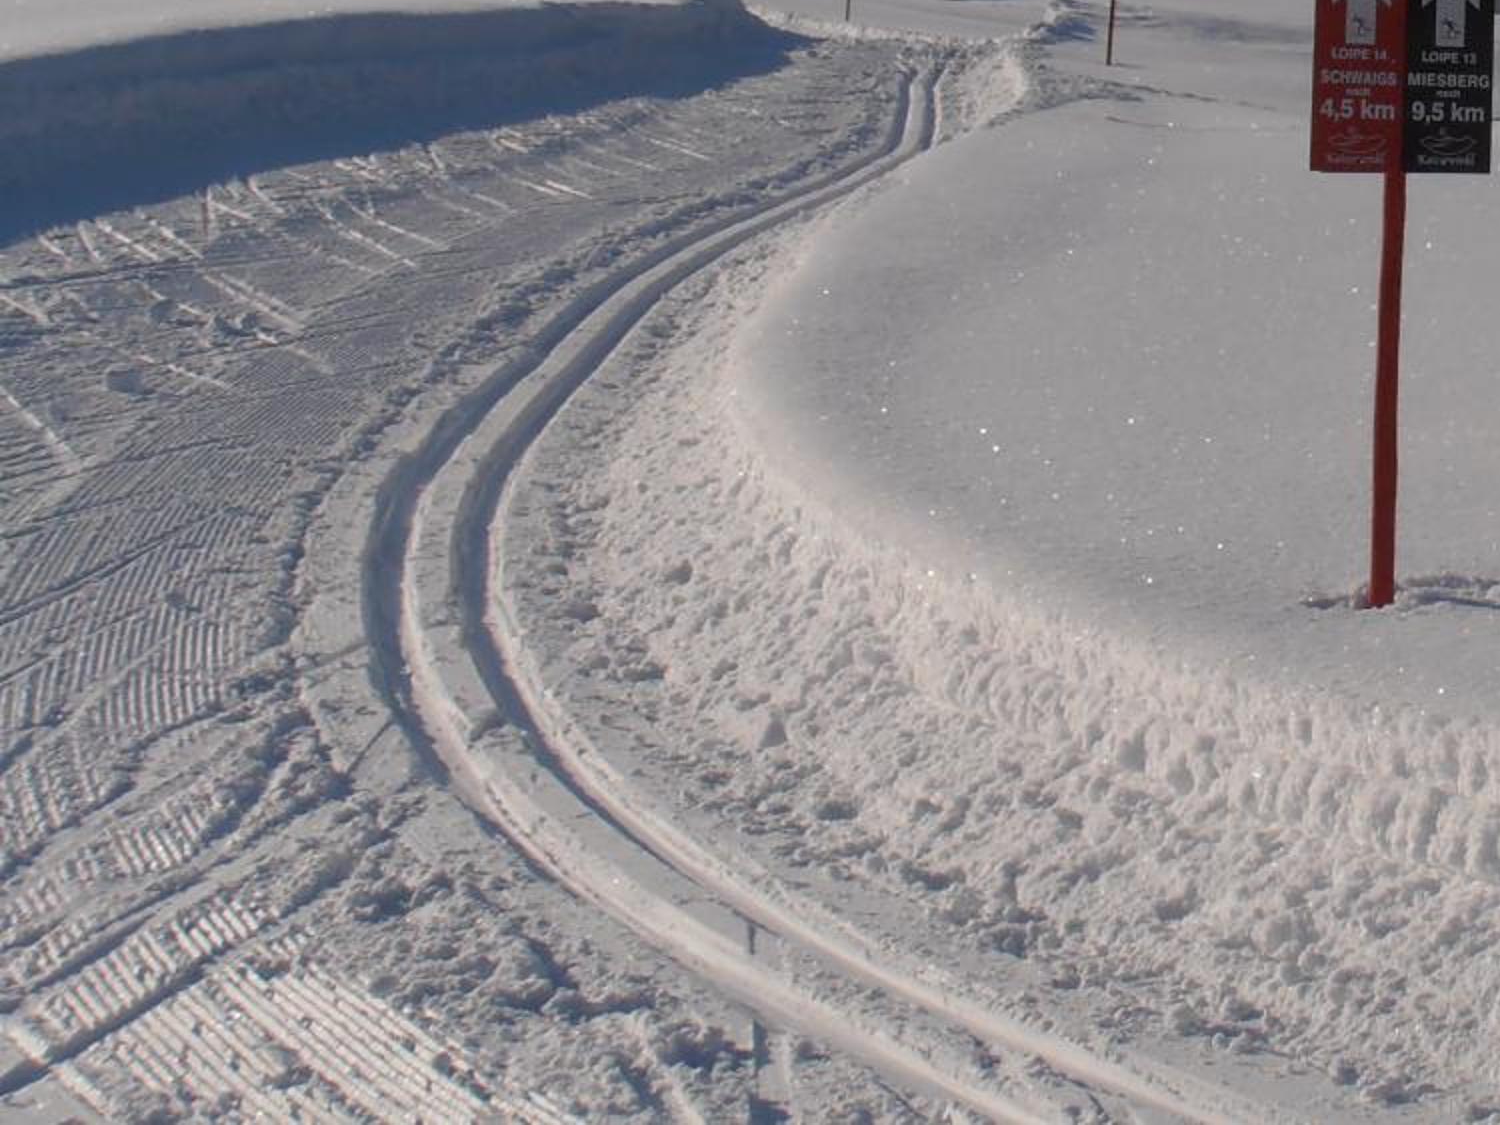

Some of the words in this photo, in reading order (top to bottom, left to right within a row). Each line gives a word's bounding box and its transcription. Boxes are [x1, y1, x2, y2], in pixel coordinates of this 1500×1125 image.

[1331, 46, 1372, 60] LOIPE
[1421, 50, 1461, 64] LOIPE
[1320, 69, 1397, 87] SCHWAIGS
[1408, 72, 1490, 89] MIESBERG
[1320, 97, 1354, 121] 4,5
[1360, 98, 1396, 120] km
[1411, 101, 1445, 123] 9,5
[1451, 102, 1485, 122] km
